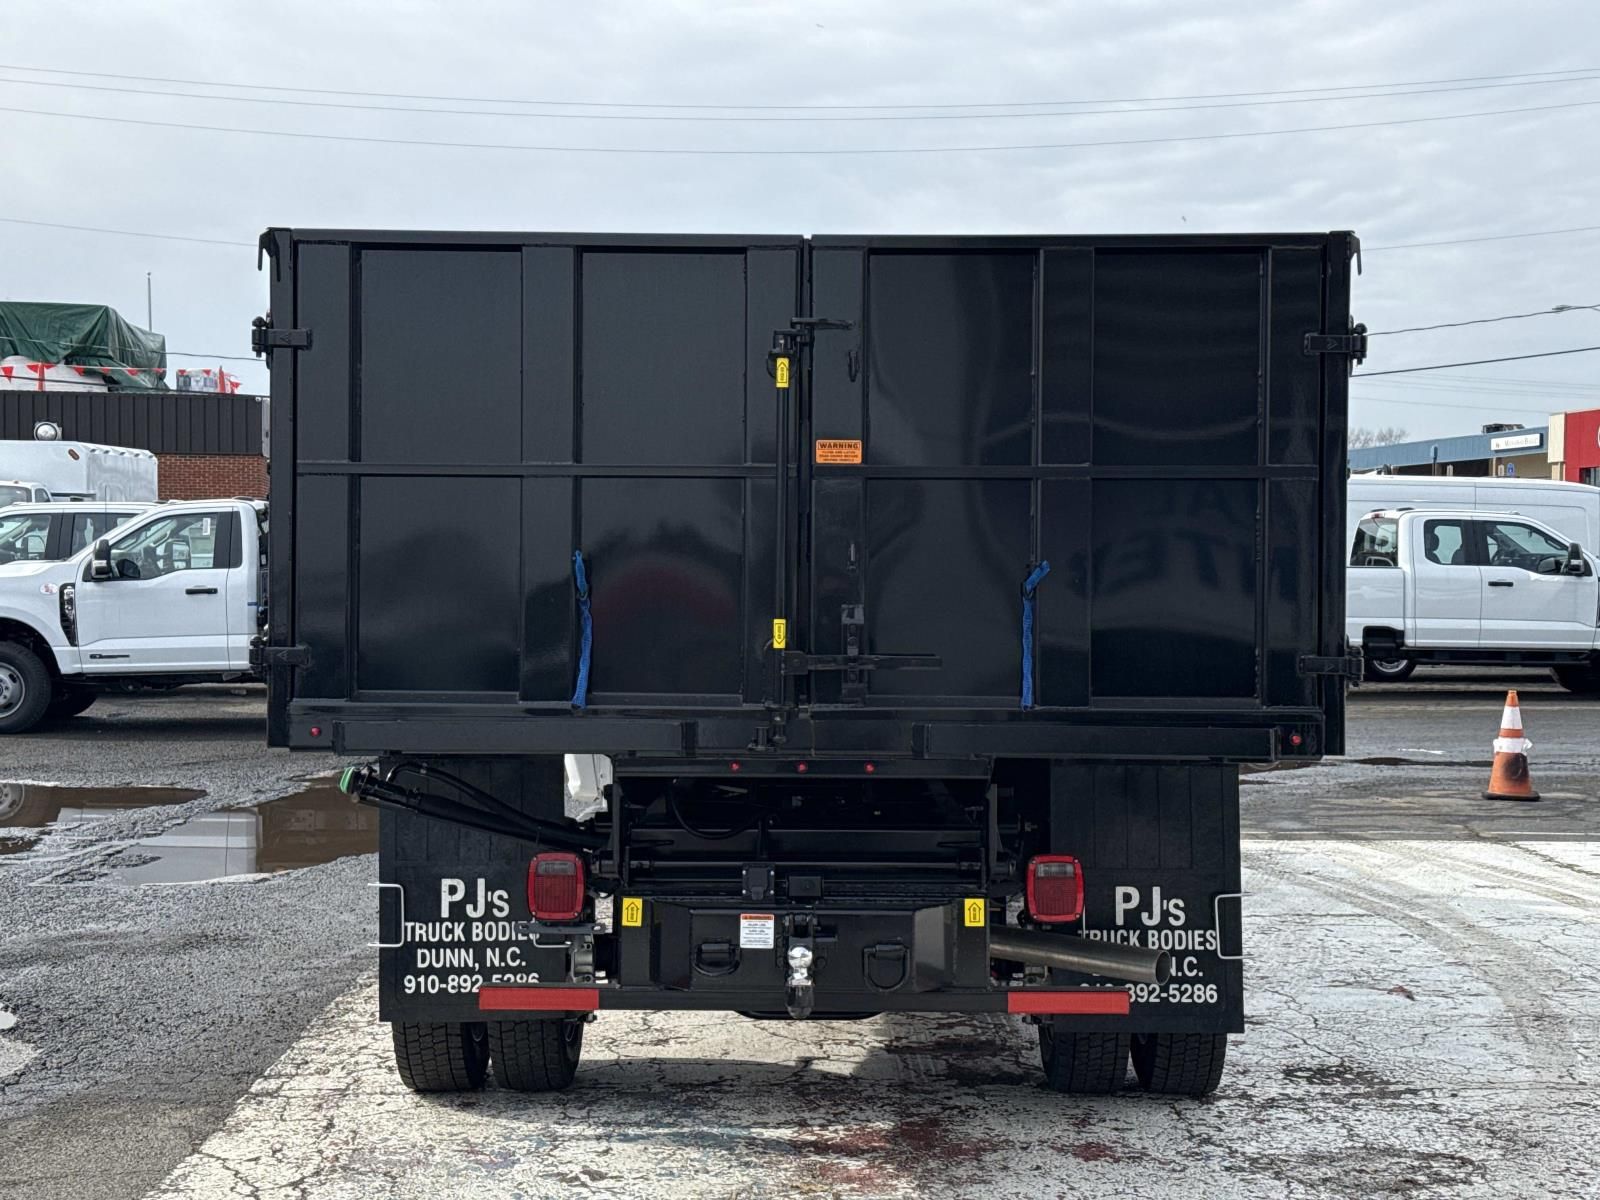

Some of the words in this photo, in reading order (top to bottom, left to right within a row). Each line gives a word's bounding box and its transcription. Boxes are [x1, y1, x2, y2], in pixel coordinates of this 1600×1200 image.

[404, 921, 466, 942] TRUCK
[1147, 929, 1217, 950] BODIES
[416, 947, 479, 971] DUNN,
[486, 947, 527, 967] N.C.
